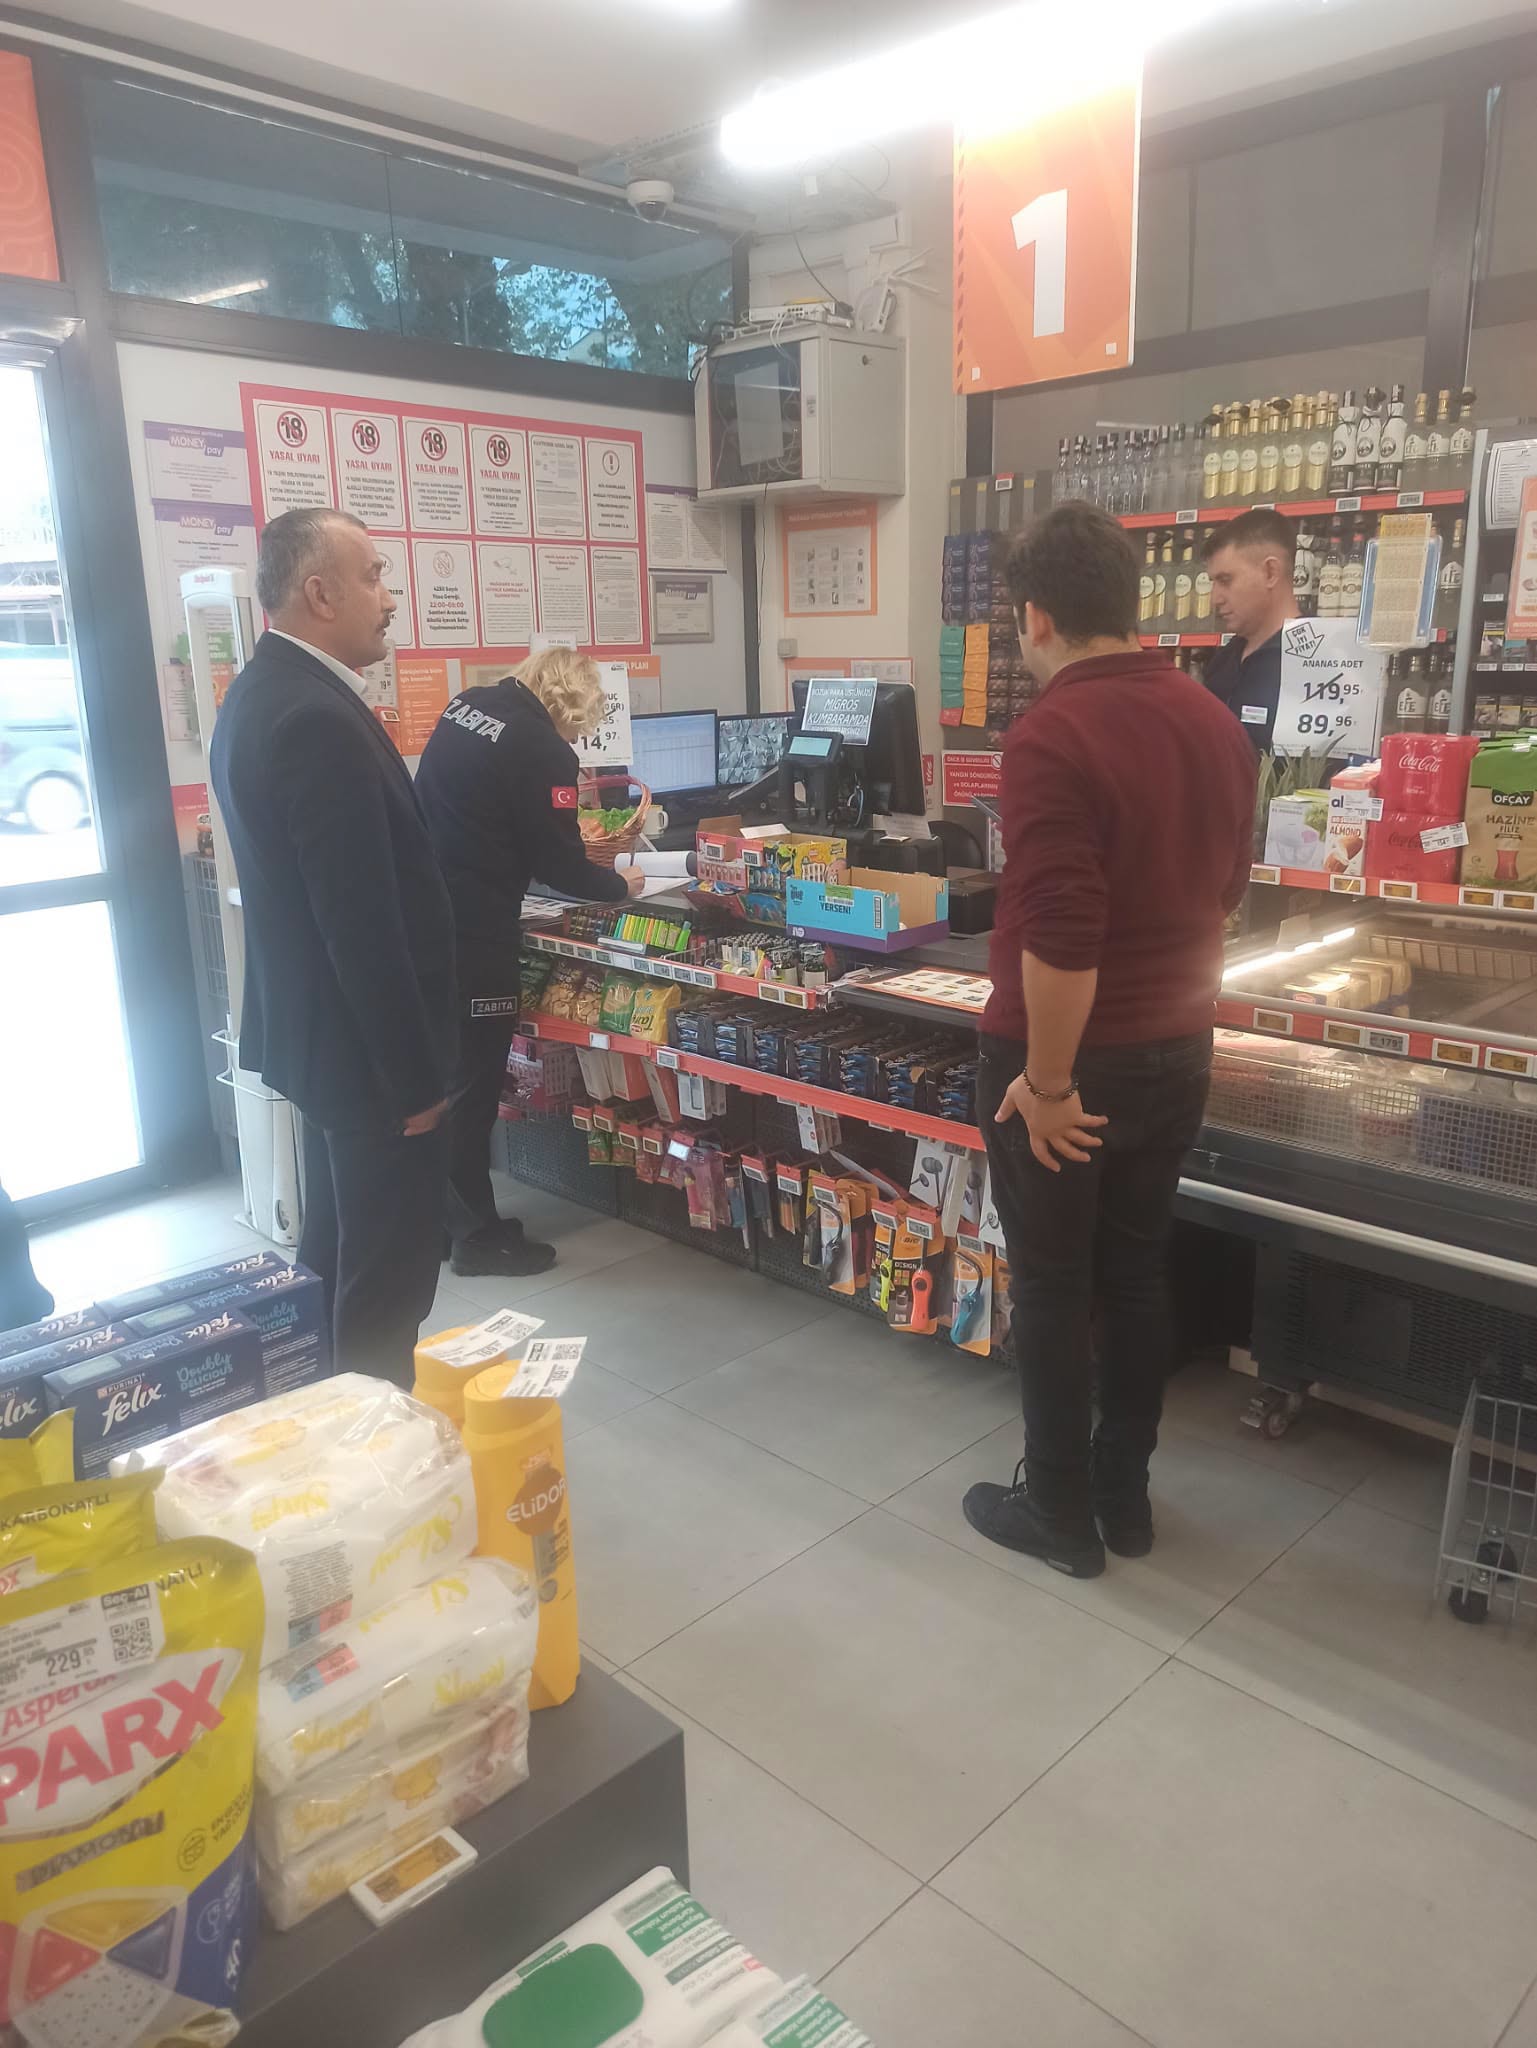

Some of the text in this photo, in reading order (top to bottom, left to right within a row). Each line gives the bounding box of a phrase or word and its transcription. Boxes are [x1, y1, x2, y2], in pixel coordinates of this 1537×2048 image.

[1011, 188, 1067, 338] 1
[170, 436, 222, 456] MONEY pay
[269, 450, 320, 463] YASAL UYARI
[345, 459, 392, 472] YASAL UYARI
[415, 464, 459, 475] YASAL UYARI
[480, 469, 520, 480] YASAL UYARI
[180, 516, 215, 529] MONEY
[1302, 660, 1364, 668] ANANAS ADET
[442, 698, 506, 743] ZABITA
[808, 712, 869, 725] KUMBARAMDA
[1494, 795, 1530, 806] OFÇAY
[1486, 813, 1536, 826] HAZİNE
[1330, 824, 1361, 837] ALMOND
[820, 902, 851, 914] YERSEN!
[476, 1001, 513, 1013] ZABITA
[185, 1311, 233, 1339] felix
[177, 1353, 231, 1379] Doubly
[106, 1374, 142, 1394] PURINA
[180, 1366, 233, 1392] DELICIOUS
[102, 1383, 165, 1437] felix
[0, 1493, 110, 1532] KARBONATLI
